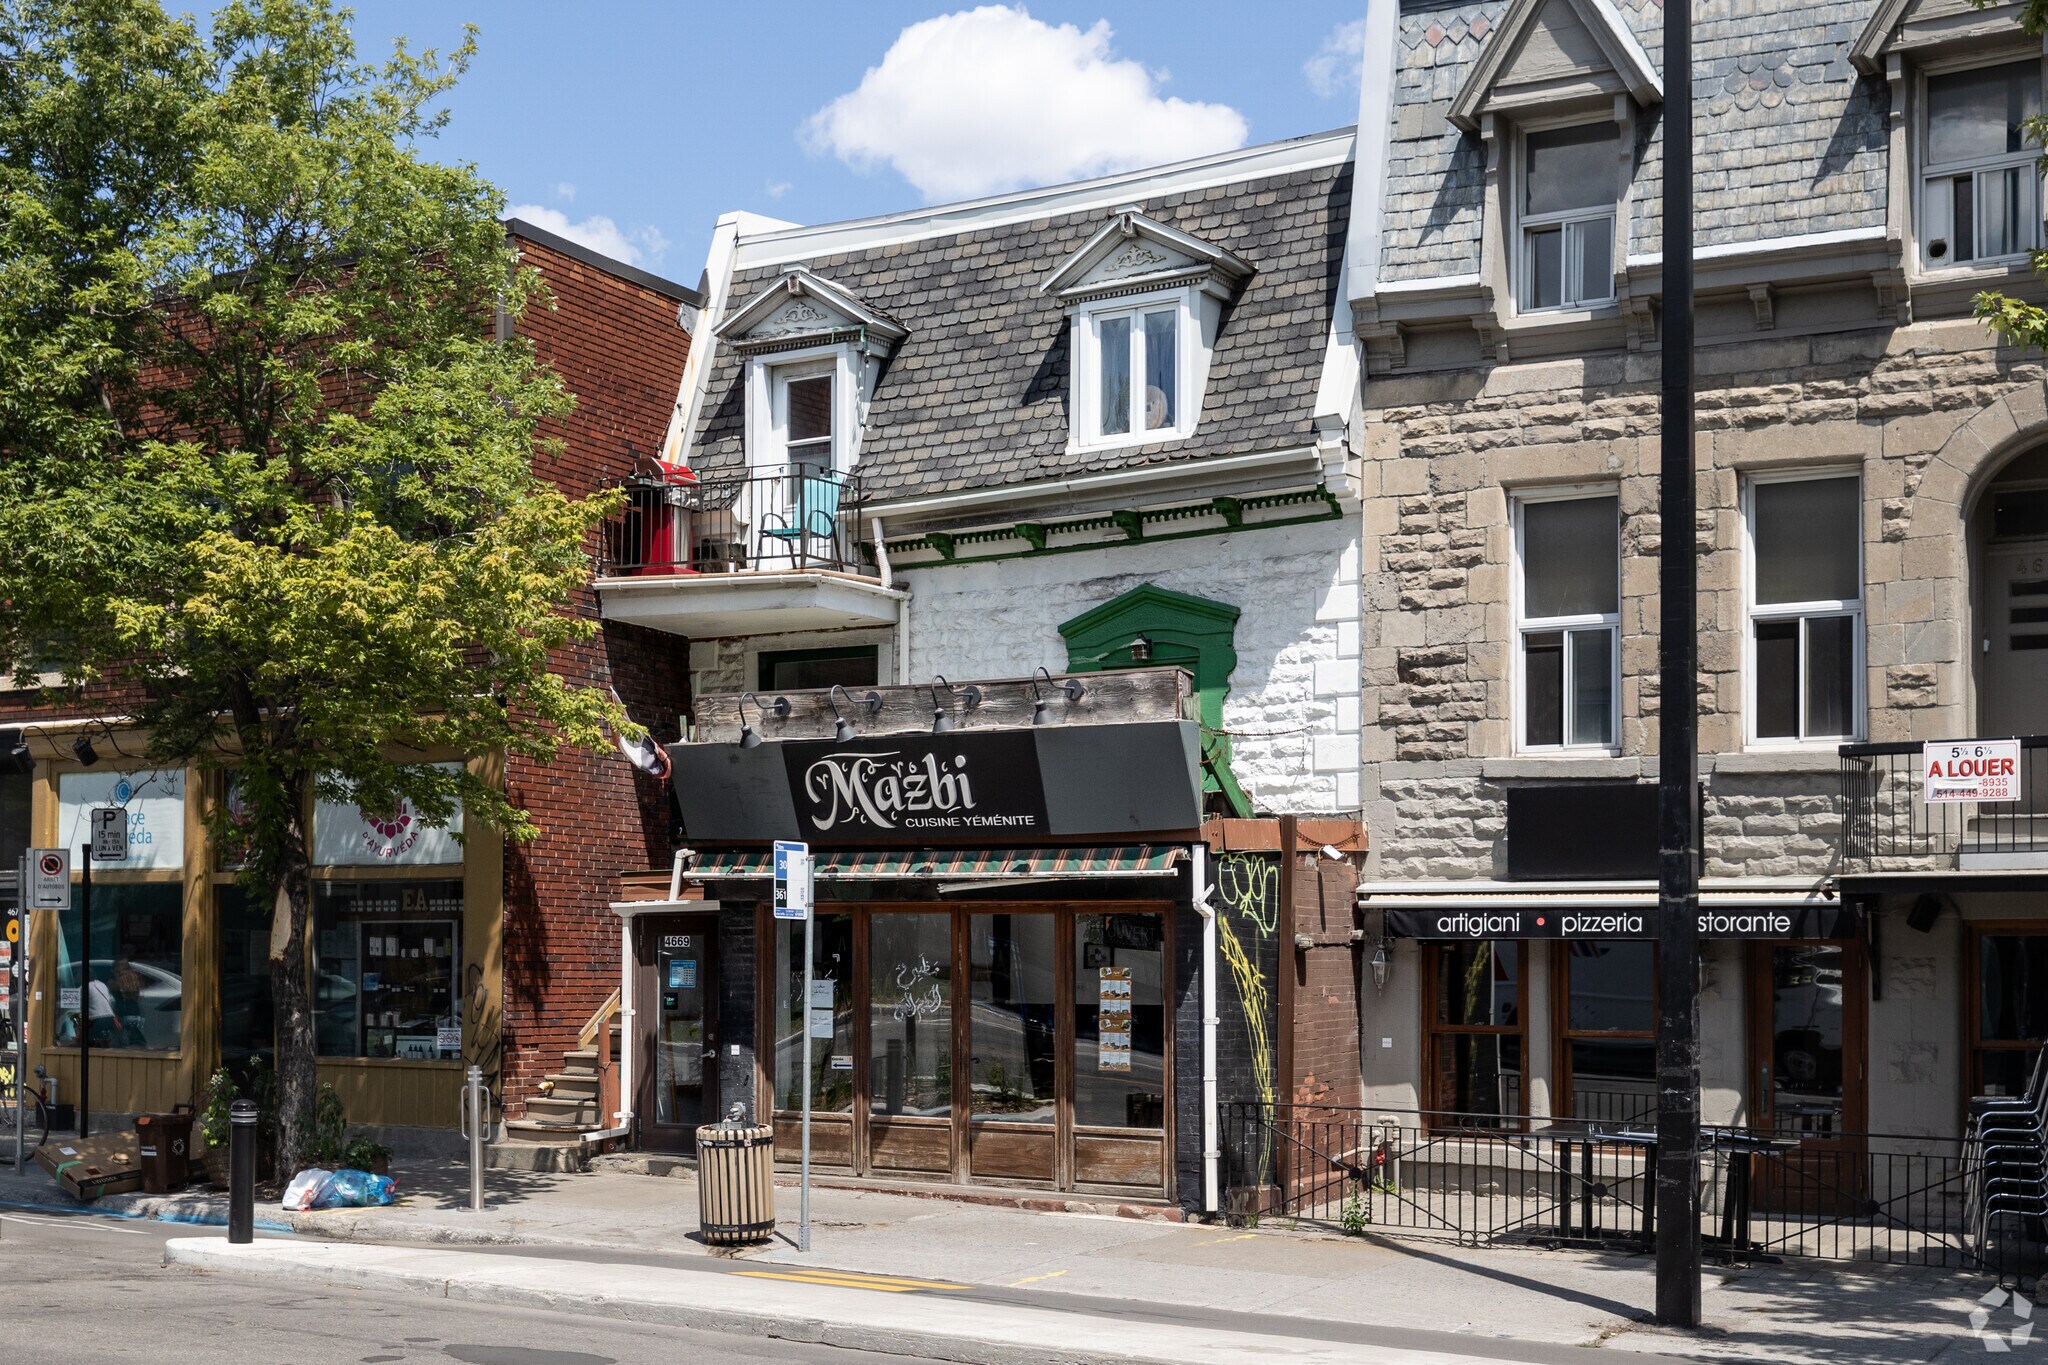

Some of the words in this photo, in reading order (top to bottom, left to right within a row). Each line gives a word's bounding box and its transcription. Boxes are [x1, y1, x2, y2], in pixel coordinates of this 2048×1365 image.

[1928, 760, 1943, 777] A
[1947, 758, 2015, 777] LOUER
[805, 751, 977, 831] Mazbi
[1936, 788, 2008, 799] 514-449-9288
[103, 811, 116, 829] P
[905, 817, 961, 828] CUISINE
[963, 814, 1035, 827] YÉMÉNITE
[775, 890, 787, 900] 361
[7, 908, 19, 916] 467
[1437, 912, 1520, 937] artigiani
[1561, 912, 1643, 936] pizzeria
[1698, 912, 1791, 932] storante
[665, 936, 690, 947] 4669
